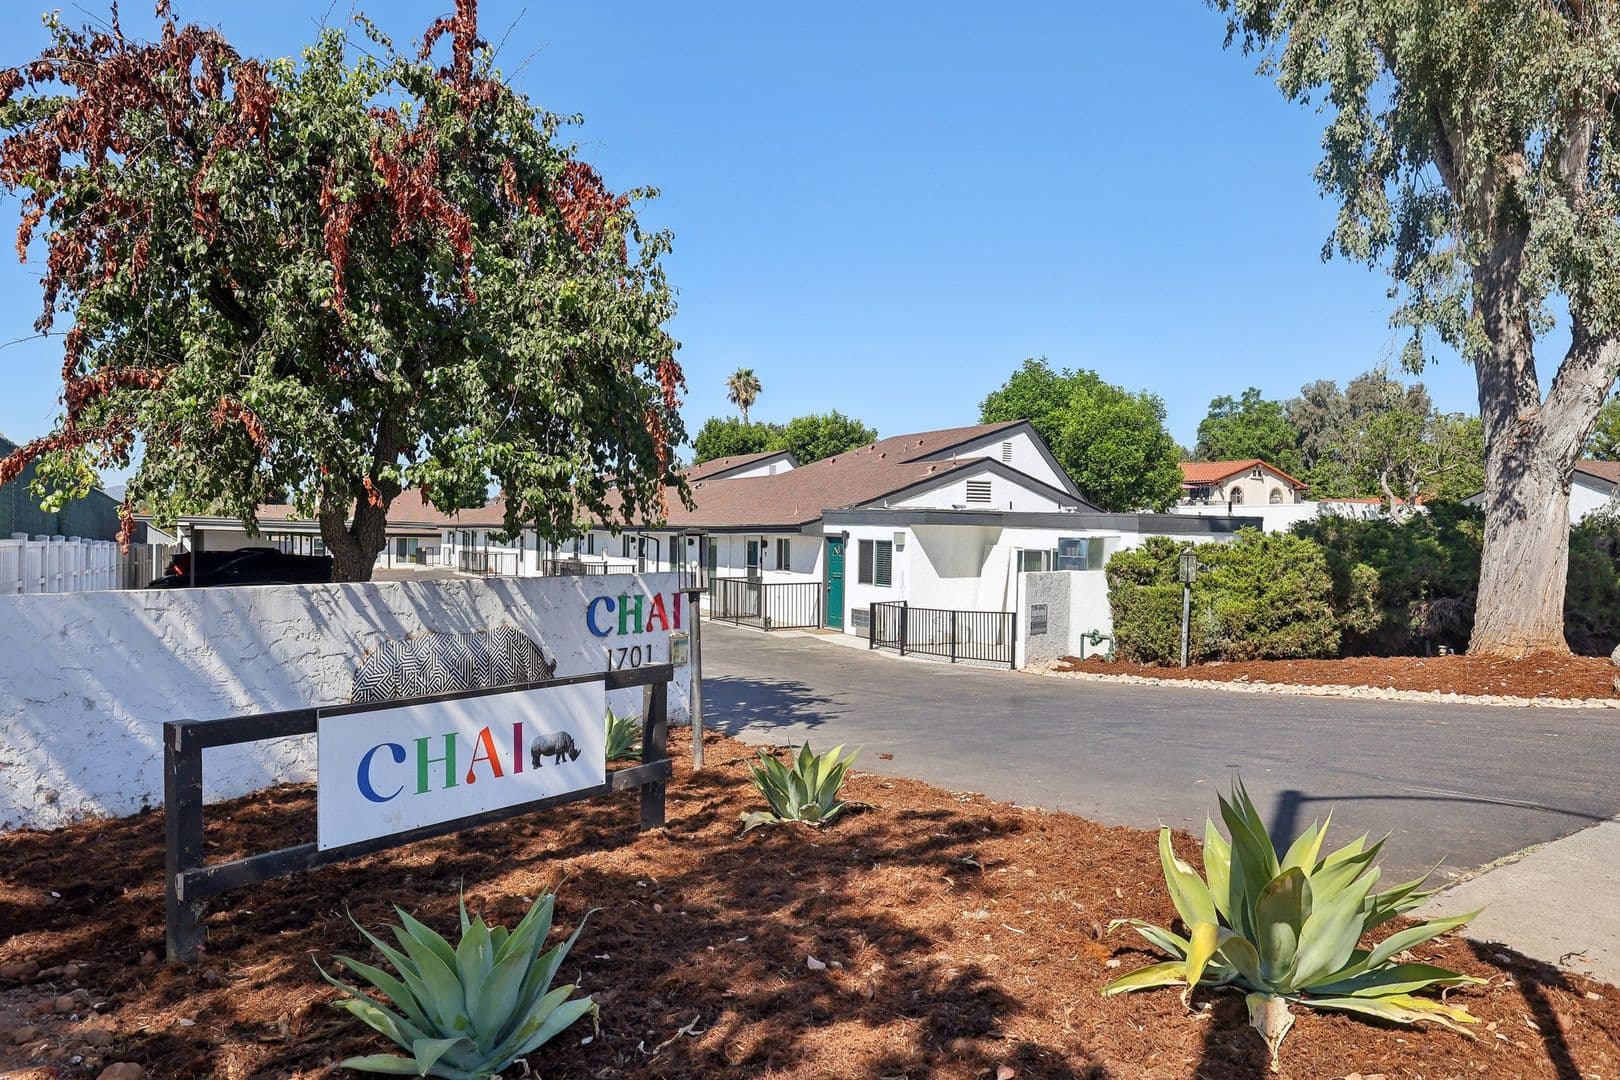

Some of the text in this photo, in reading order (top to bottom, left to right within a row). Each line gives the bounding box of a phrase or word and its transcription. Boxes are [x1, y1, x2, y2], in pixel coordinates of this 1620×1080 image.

[586, 592, 682, 638] CHAI
[608, 644, 653, 671] 1701
[356, 721, 524, 803] CHAI
